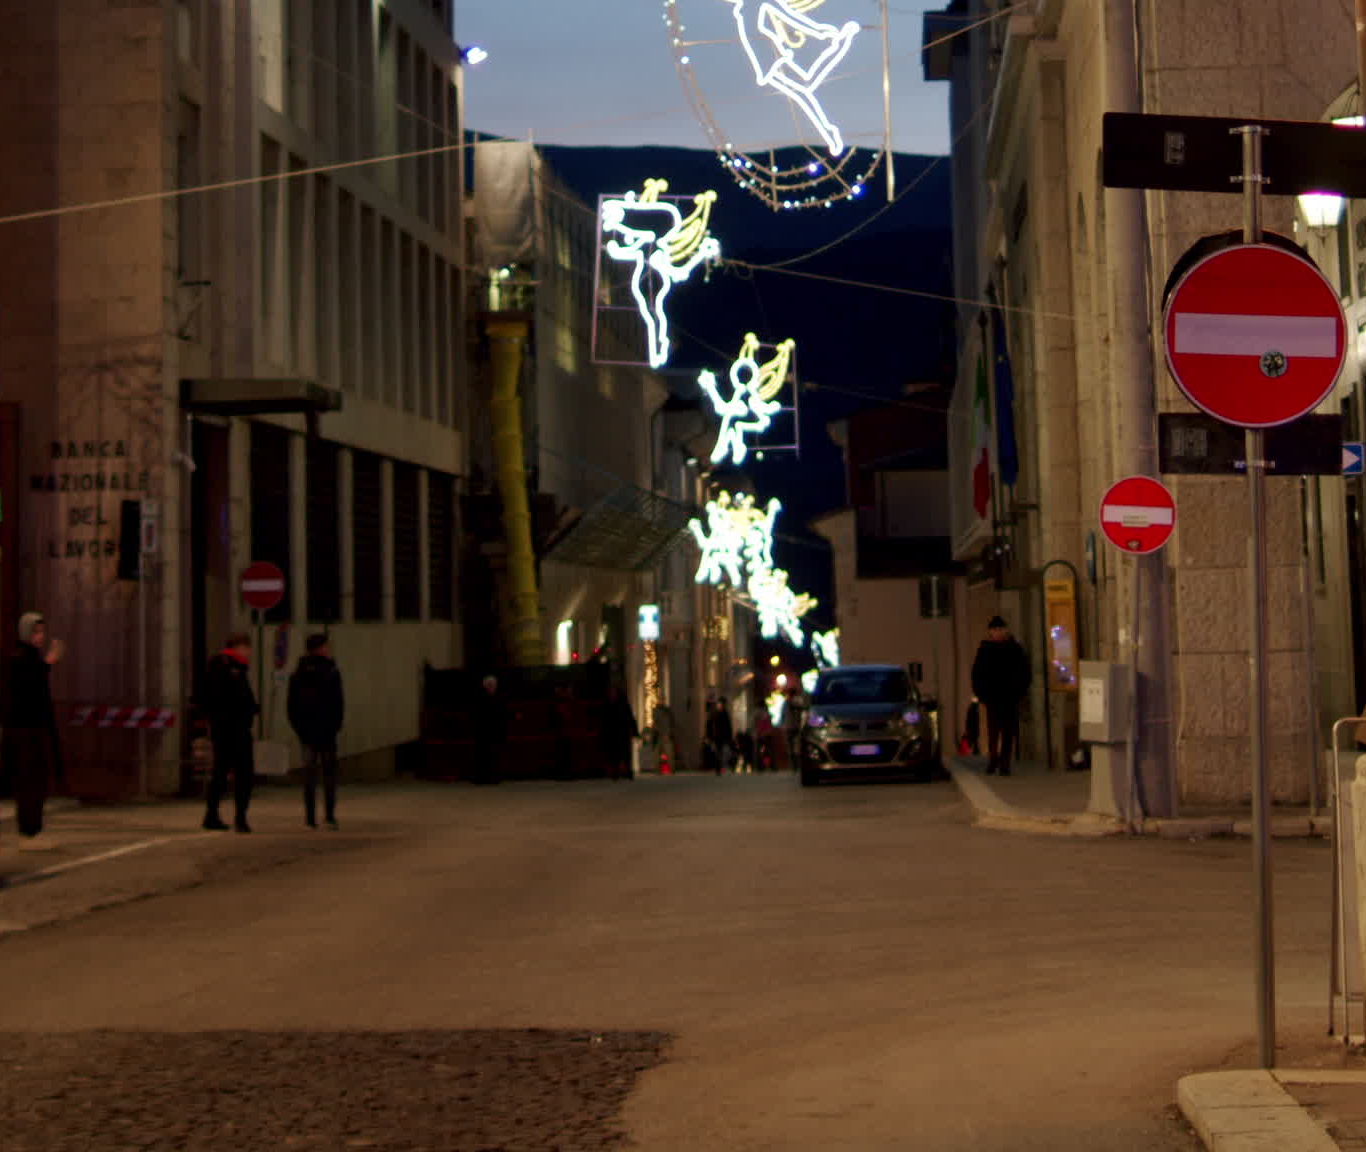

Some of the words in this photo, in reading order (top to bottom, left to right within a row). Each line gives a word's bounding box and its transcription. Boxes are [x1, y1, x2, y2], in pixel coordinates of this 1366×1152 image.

[51, 440, 125, 458] BANCA
[30, 470, 150, 491] NAZIONALE
[68, 504, 108, 525] DEL
[47, 539, 119, 558] LAVOR
